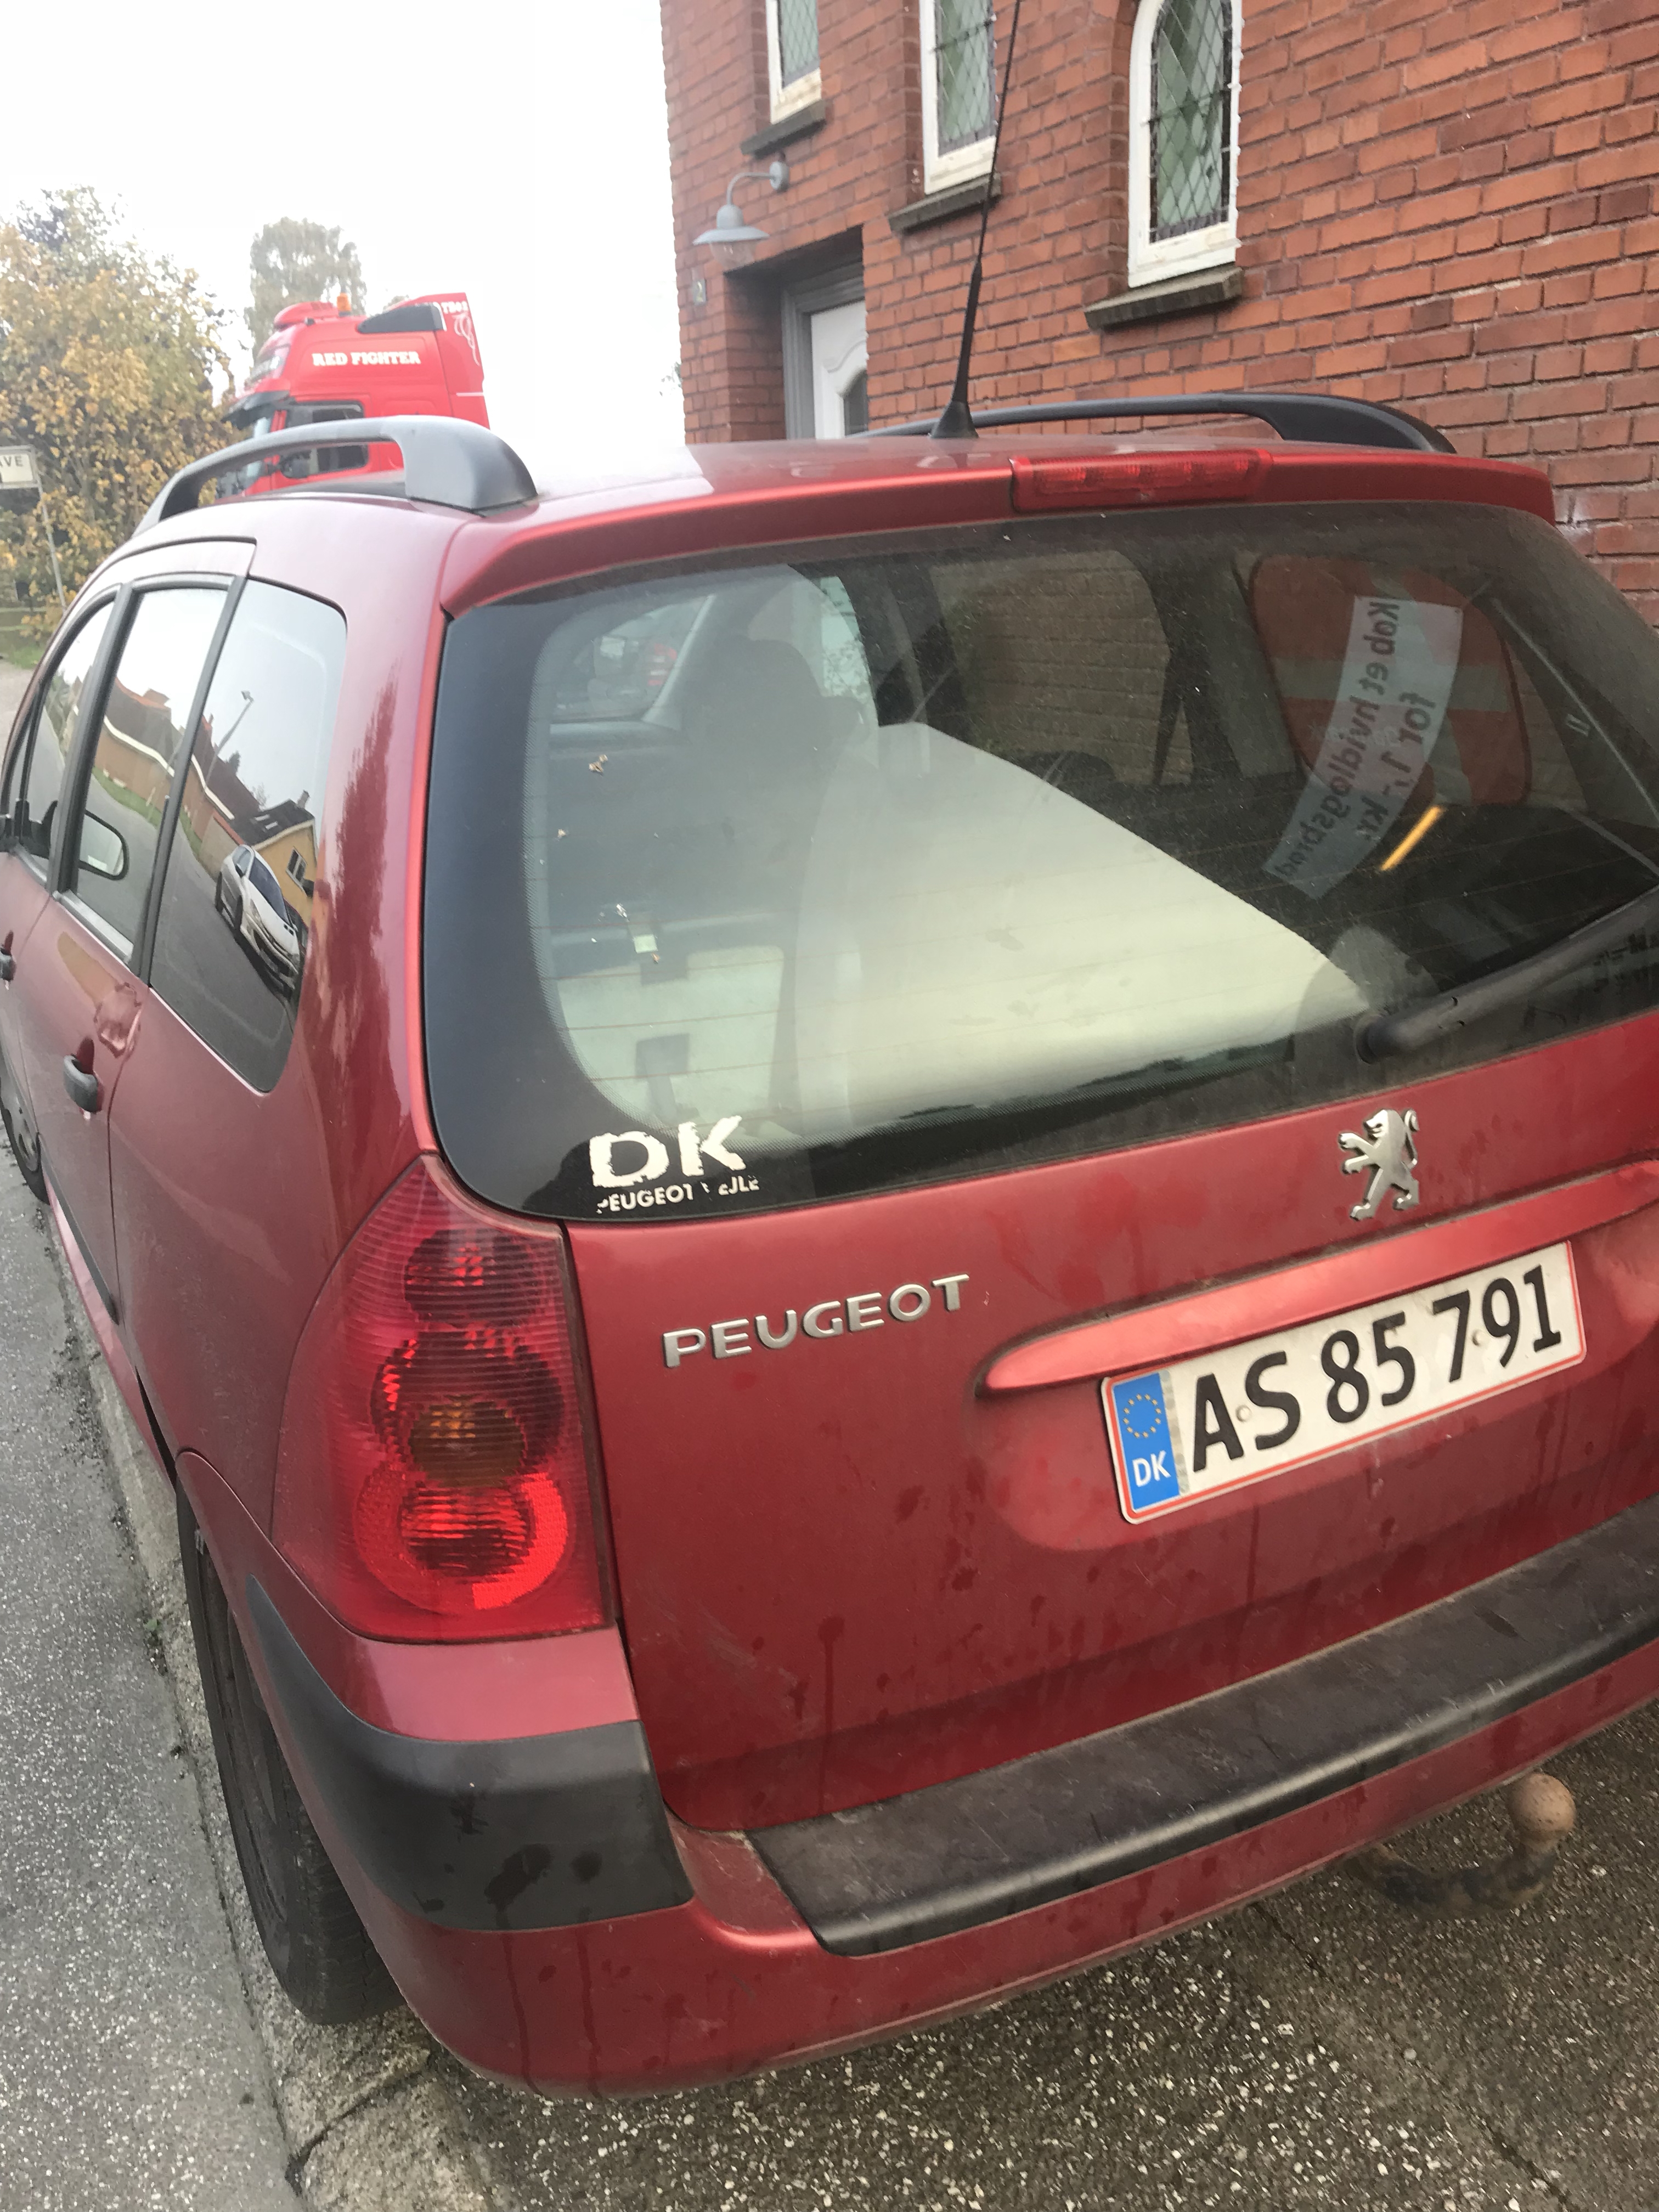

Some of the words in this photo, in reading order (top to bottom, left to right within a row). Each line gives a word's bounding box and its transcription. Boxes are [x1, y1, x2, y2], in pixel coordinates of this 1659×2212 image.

[312, 352, 348, 366] RED
[350, 351, 421, 365] FIGHTER
[0, 455, 23, 467] VE
[589, 1115, 747, 1188] DK
[662, 1273, 970, 1368] PEUGEOT
[1192, 1350, 1302, 1473] AS
[1320, 1311, 1416, 1424] 85
[1432, 1264, 1561, 1384] 791
[1132, 1450, 1171, 1488] DK
